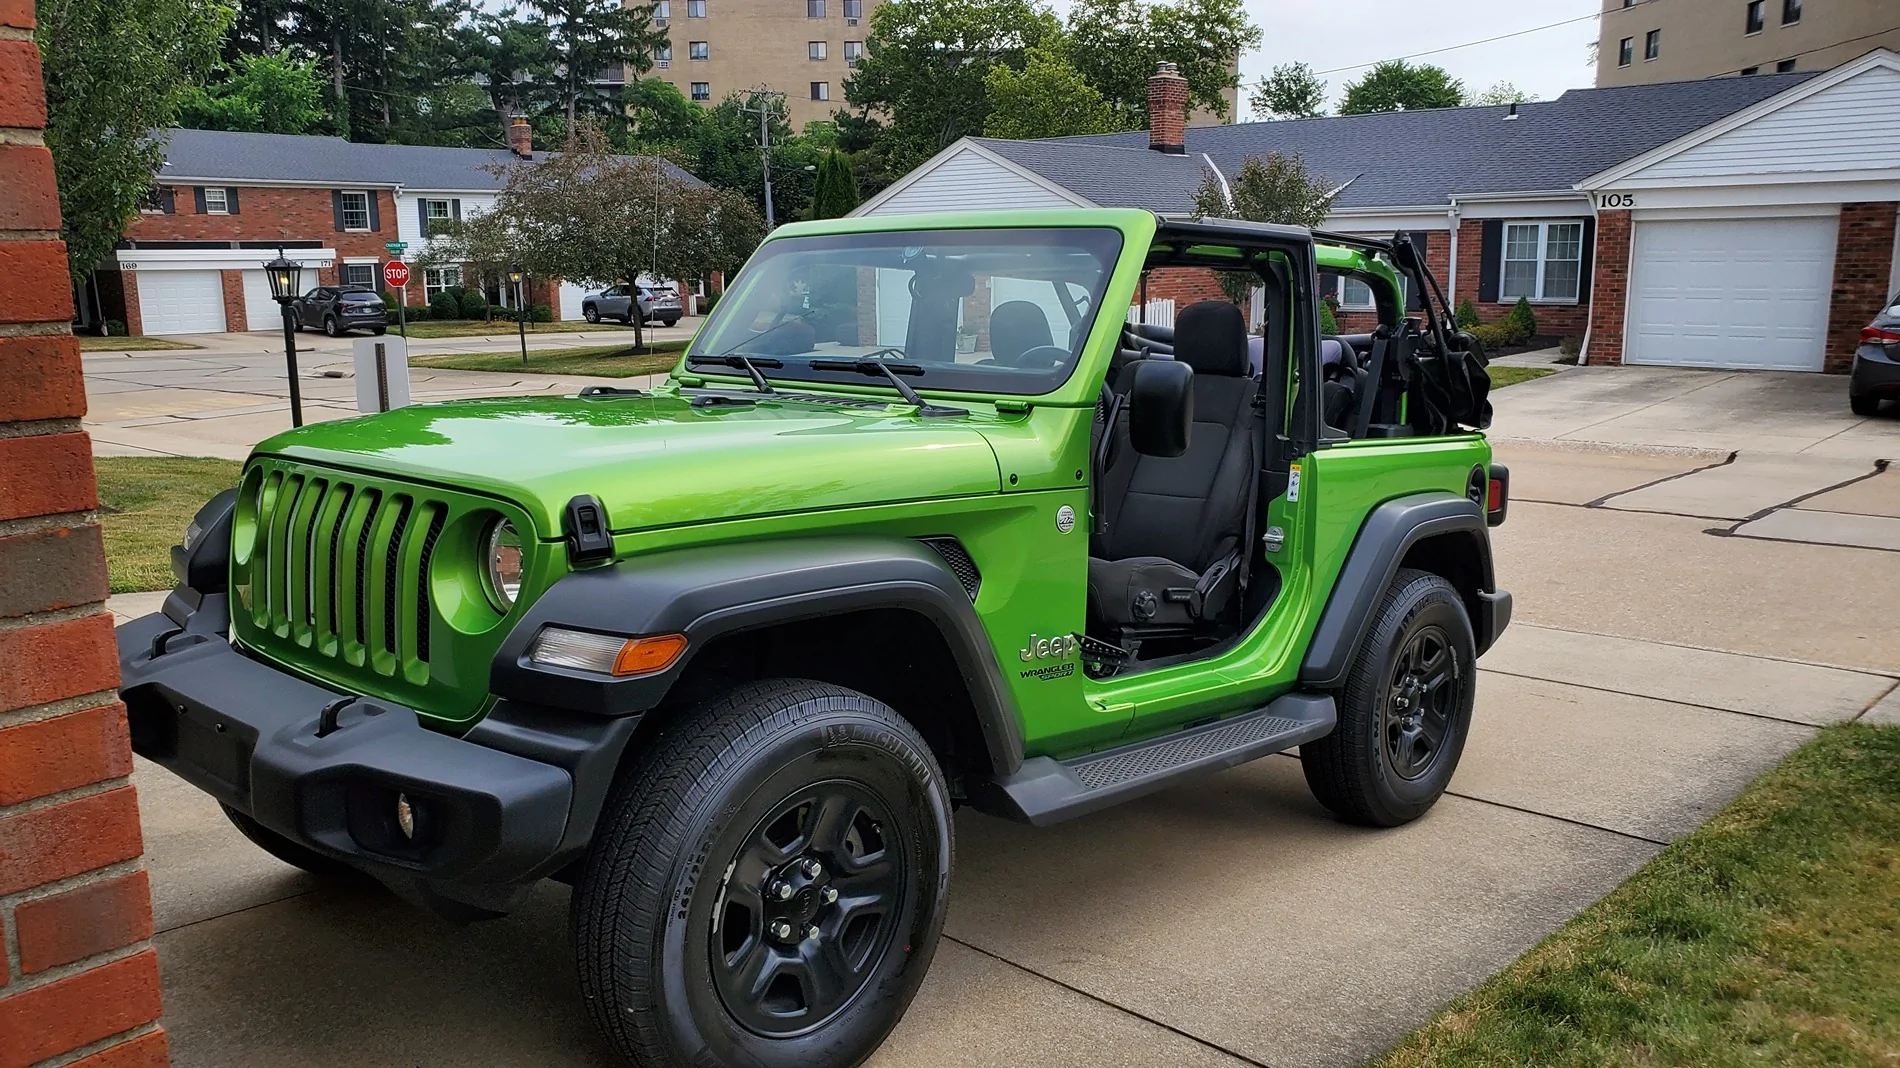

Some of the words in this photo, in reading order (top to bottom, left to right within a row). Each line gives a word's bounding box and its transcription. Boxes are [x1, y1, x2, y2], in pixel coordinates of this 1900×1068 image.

[1600, 193, 1634, 208] 105
[121, 262, 138, 270] 169
[386, 268, 408, 279] STOP
[1020, 633, 1077, 663] Jeep
[1020, 662, 1075, 679] WRANGLER
[1040, 670, 1073, 681] SPORT
[852, 724, 932, 786] MICHELIN
